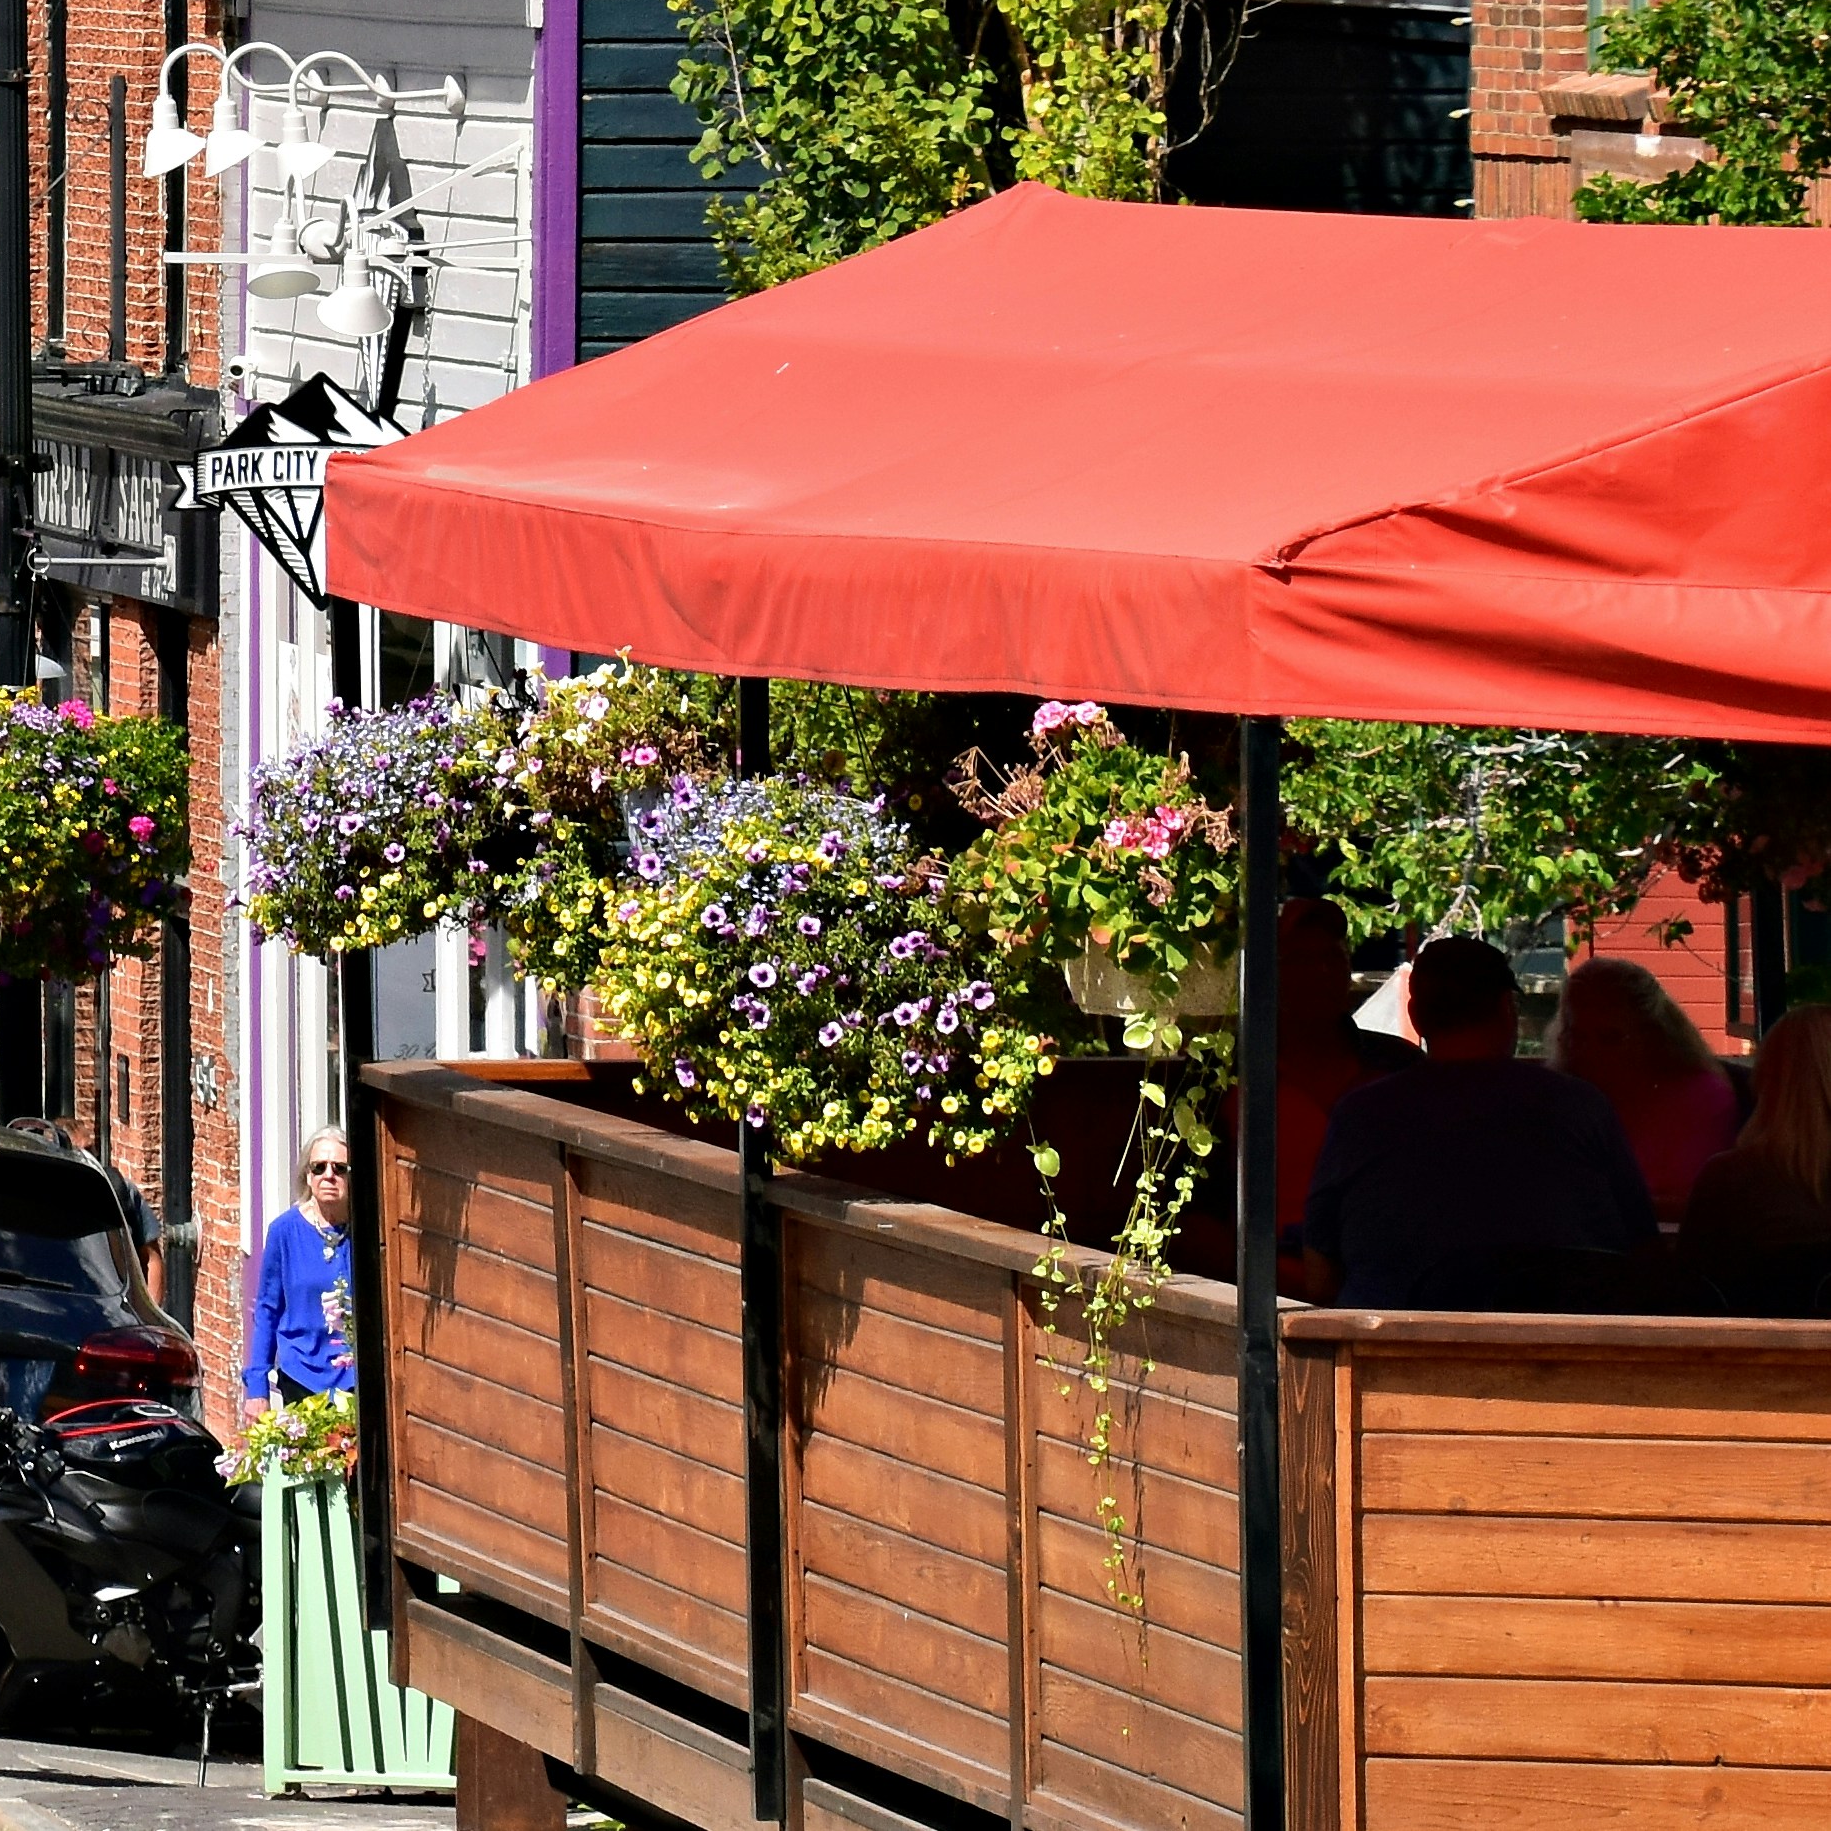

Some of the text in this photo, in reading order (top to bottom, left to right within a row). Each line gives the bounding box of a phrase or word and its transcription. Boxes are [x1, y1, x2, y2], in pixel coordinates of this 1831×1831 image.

[211, 450, 319, 488] PARK CITY
[33, 439, 162, 547] URPLE SAGE
[108, 1429, 165, 1451] Kawasaki
